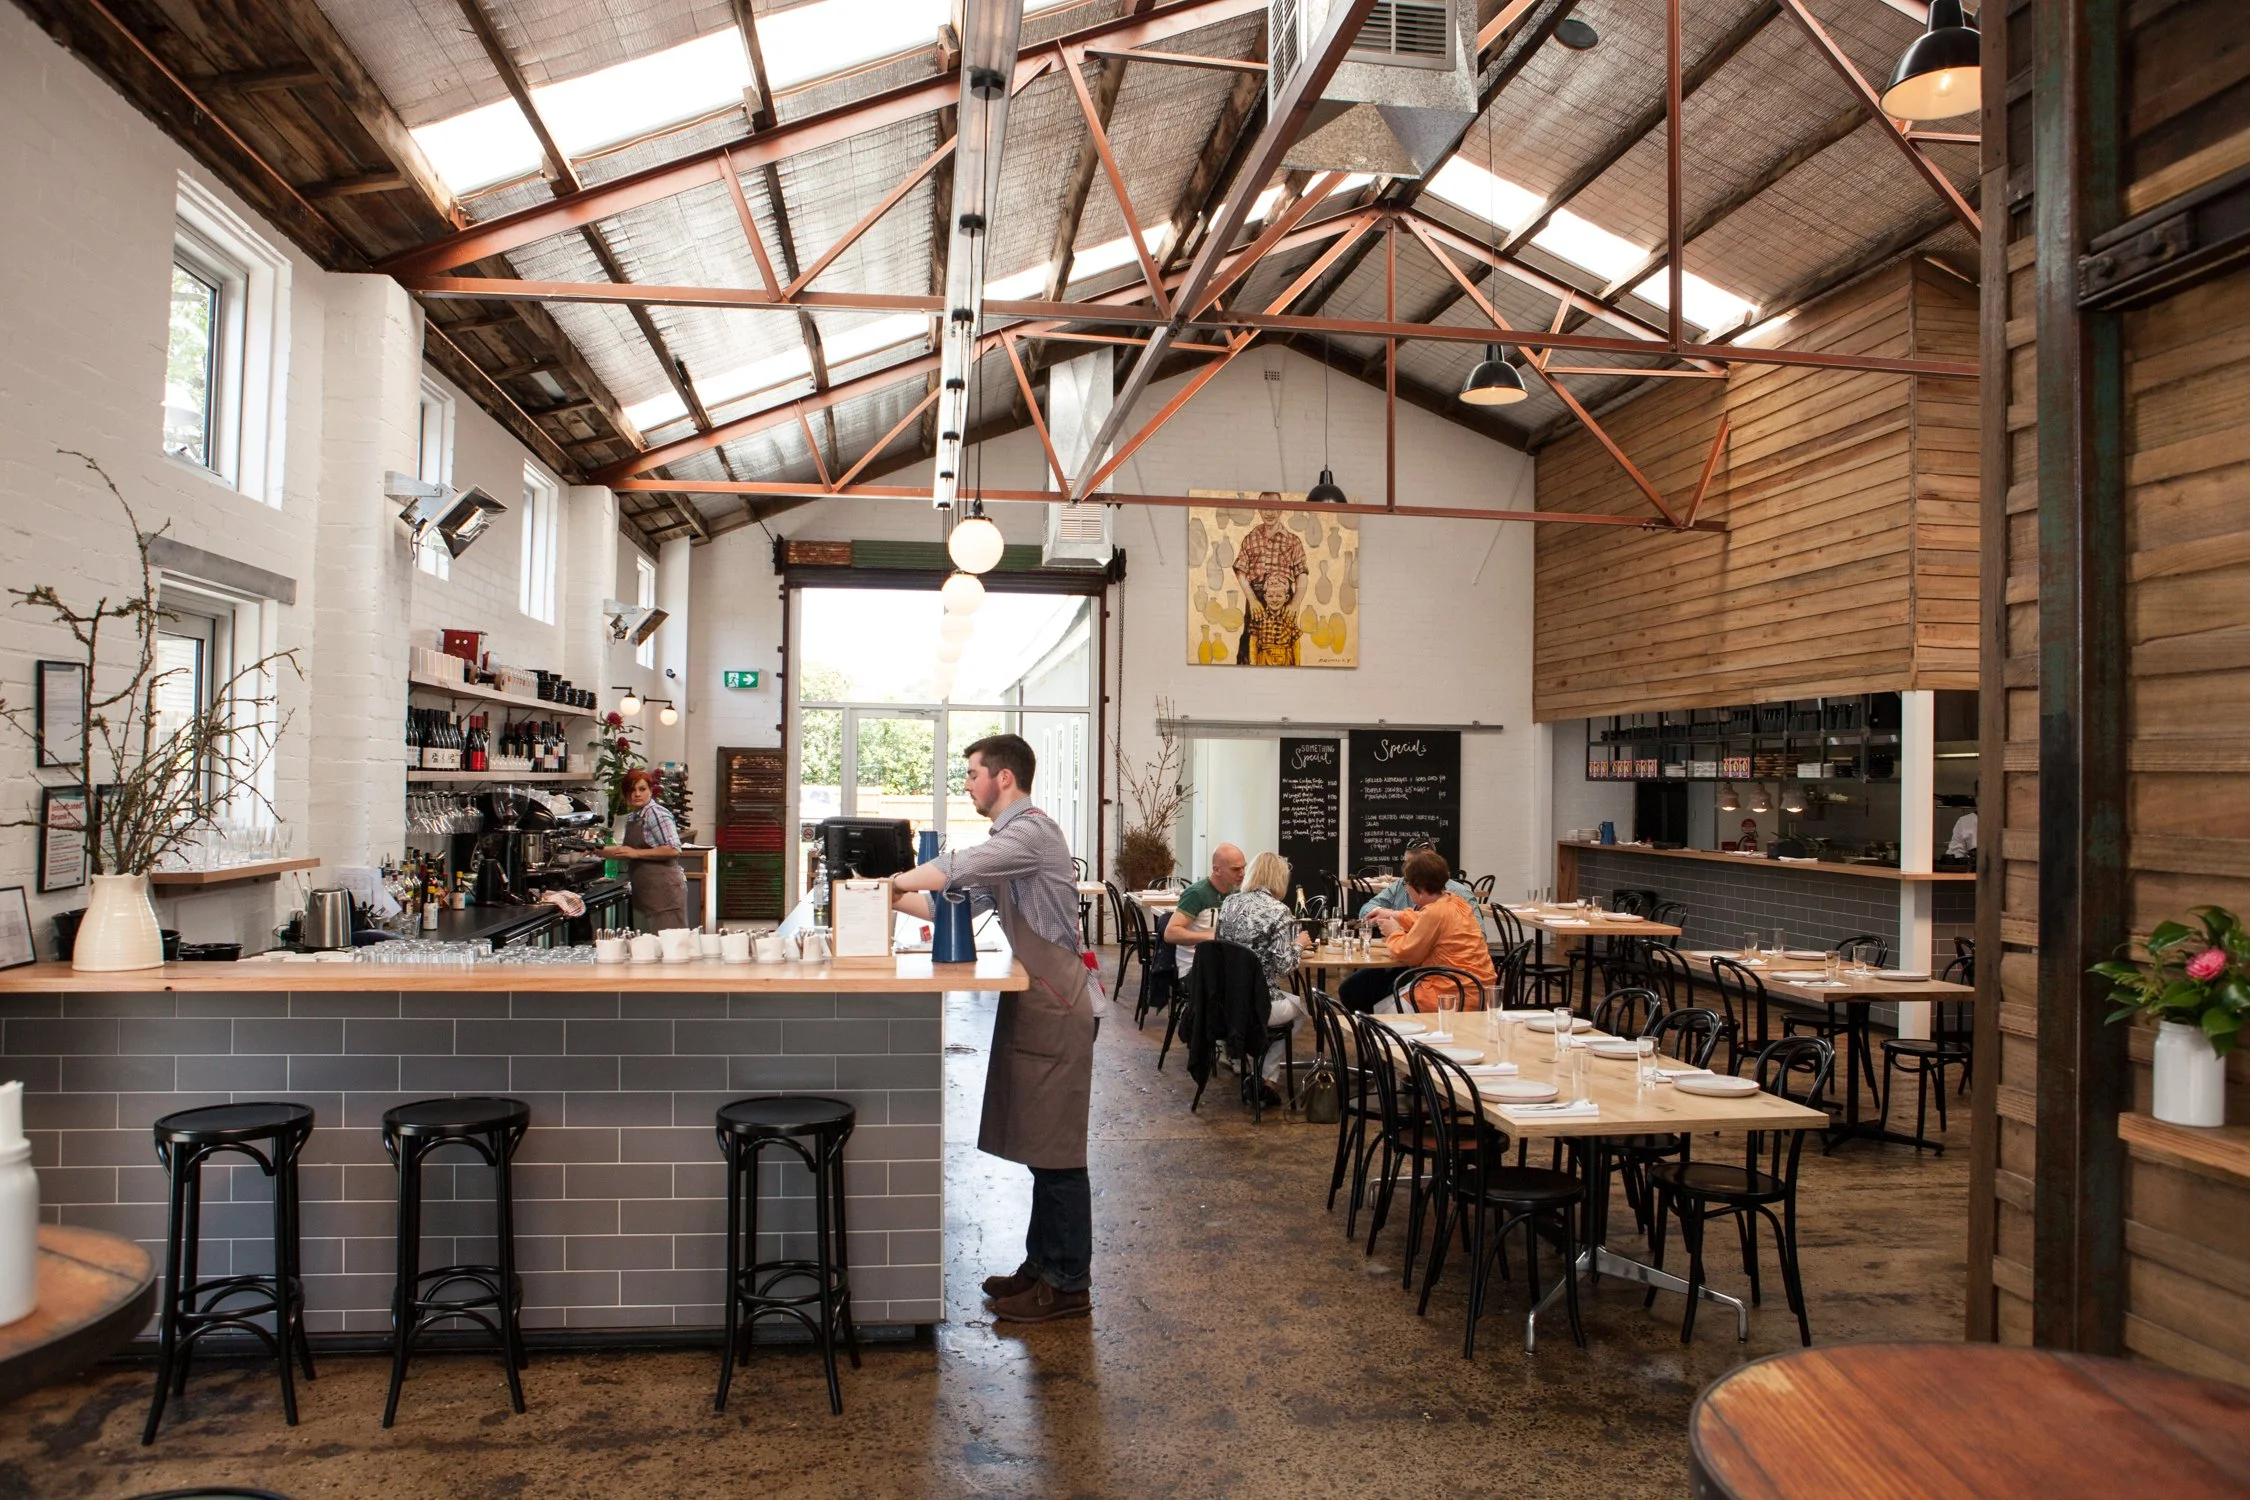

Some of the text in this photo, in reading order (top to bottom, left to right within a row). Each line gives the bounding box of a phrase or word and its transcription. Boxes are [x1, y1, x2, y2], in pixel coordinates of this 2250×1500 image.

[1291, 748, 1332, 770] Special
[1301, 744, 1335, 753] SOMETHING
[1373, 738, 1427, 762] Specials
